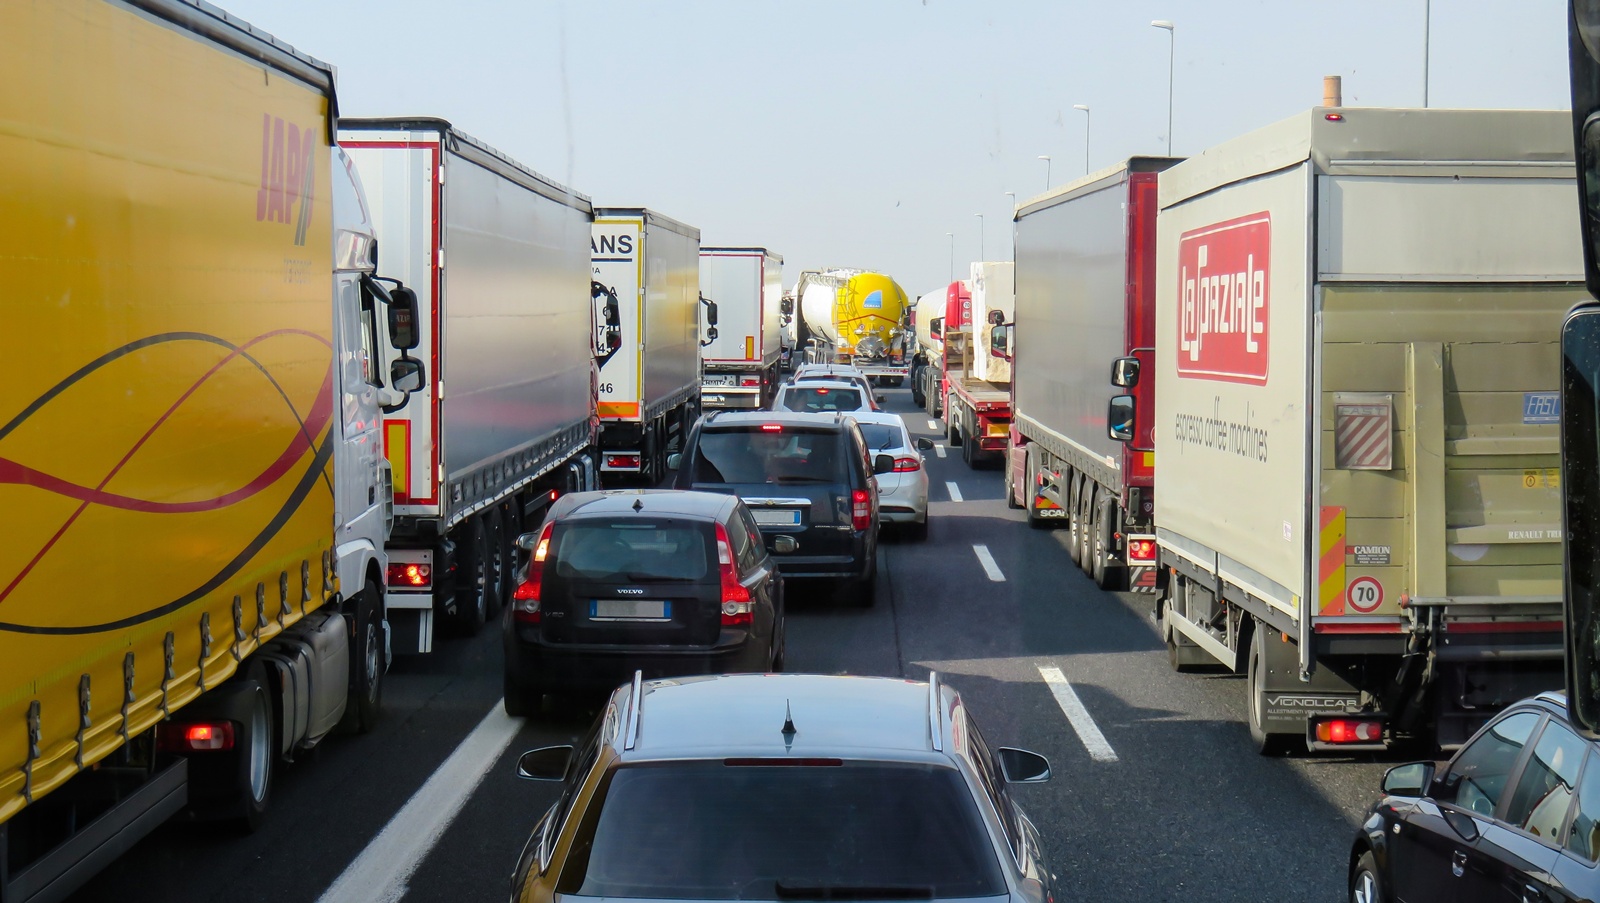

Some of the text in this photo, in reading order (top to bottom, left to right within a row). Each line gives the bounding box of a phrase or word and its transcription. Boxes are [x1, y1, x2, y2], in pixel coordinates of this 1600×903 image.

[1527, 395, 1560, 415] FAST
[1175, 396, 1268, 463] espresso coffee machines
[1508, 530, 1544, 540] RENAULT
[1357, 587, 1375, 602] 70
[1267, 695, 1357, 707] VIGNOLCAR
